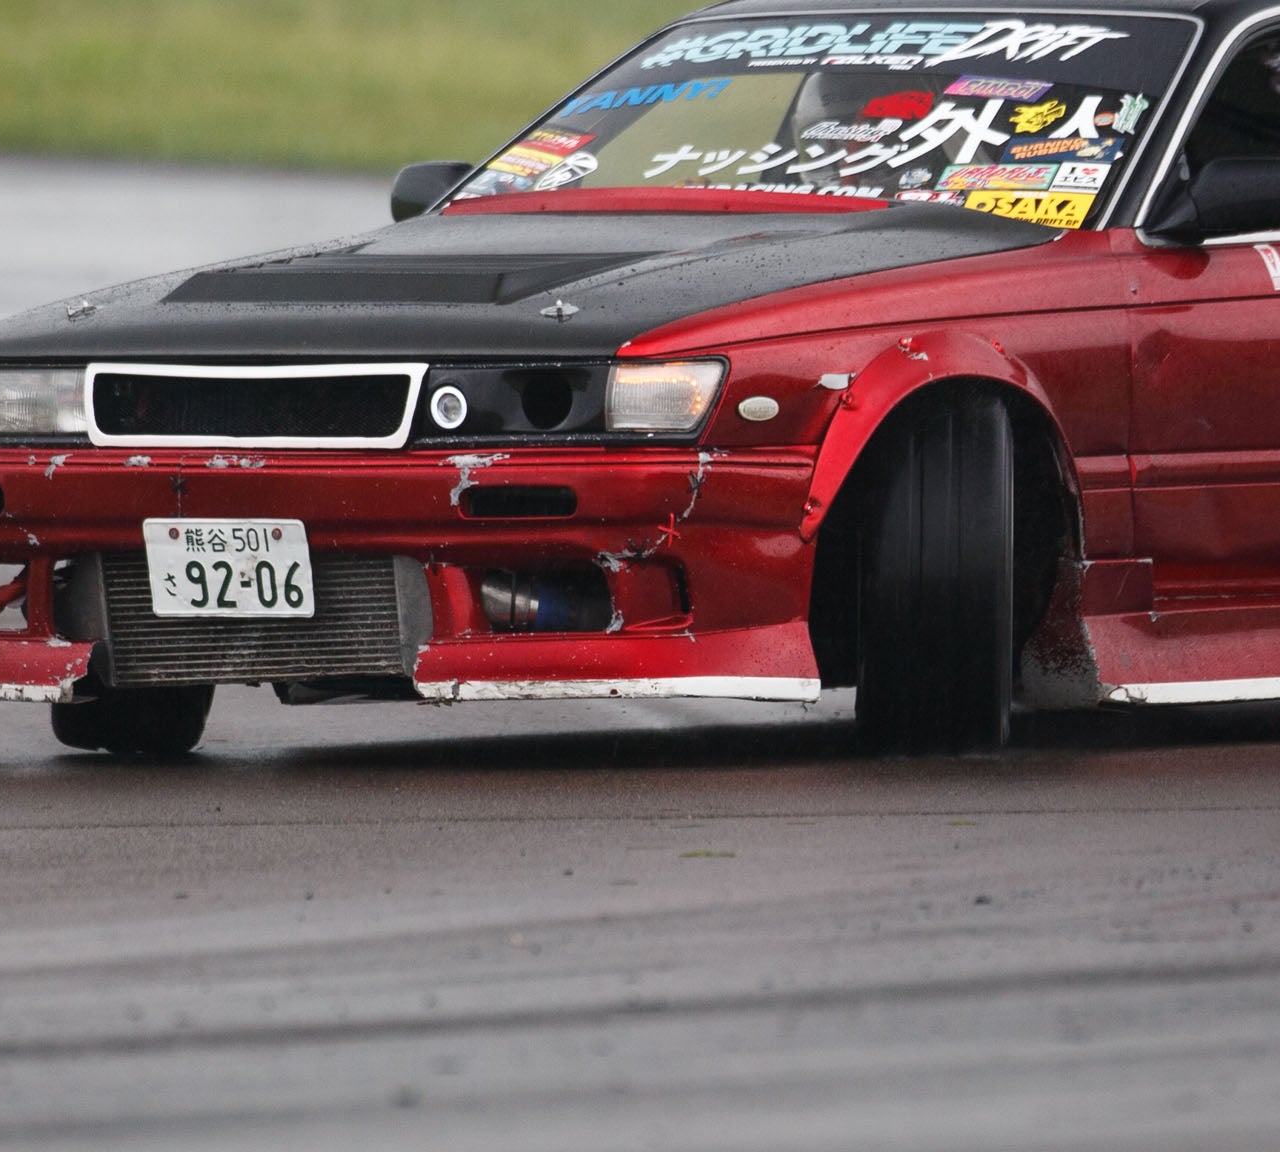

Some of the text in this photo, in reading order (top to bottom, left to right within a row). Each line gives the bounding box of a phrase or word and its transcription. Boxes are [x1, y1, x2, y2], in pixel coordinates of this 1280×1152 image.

[1010, 137, 1084, 153] BURNING
[1014, 142, 1081, 159] RUBBER
[643, 142, 909, 179] ナッシング
[968, 194, 1080, 218] OSAKA
[231, 528, 270, 552] 501
[164, 572, 177, 597] さ
[185, 560, 304, 608] 92-06
